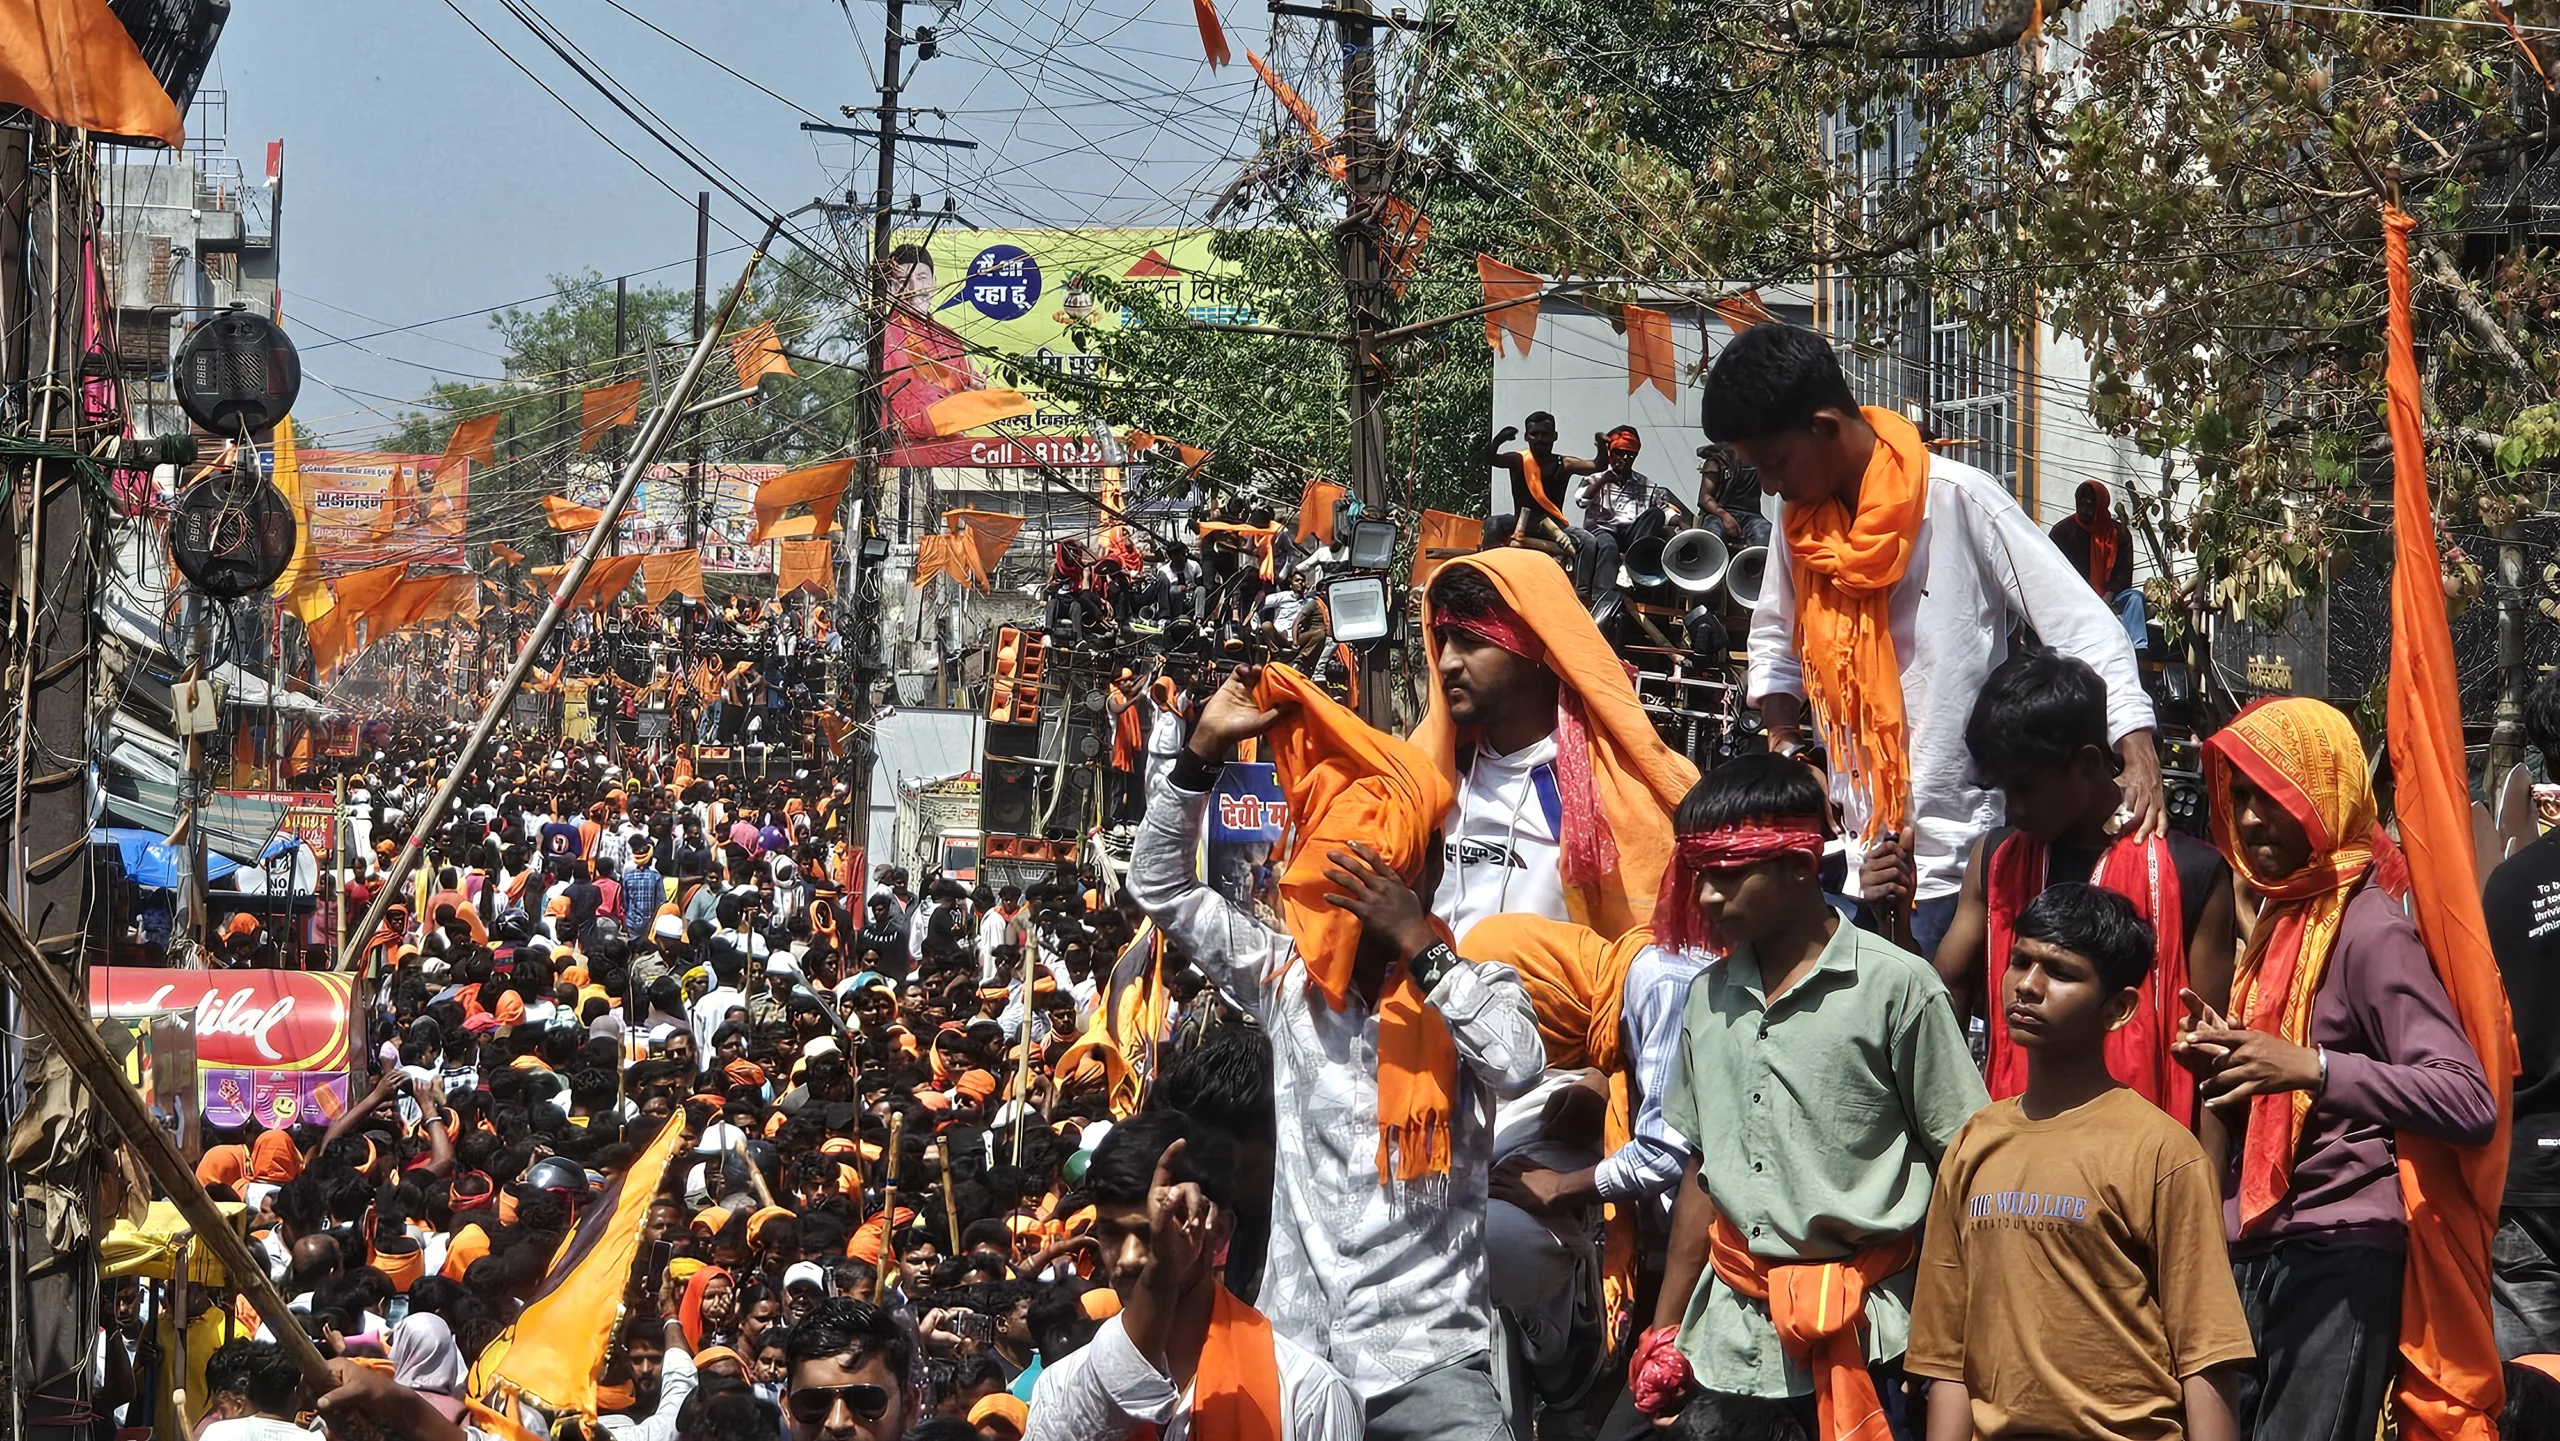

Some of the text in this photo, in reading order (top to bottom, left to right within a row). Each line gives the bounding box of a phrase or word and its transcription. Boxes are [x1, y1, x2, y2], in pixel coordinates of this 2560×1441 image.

[973, 285, 1008, 305] रहा
[971, 442, 1012, 464] Call
[1219, 794, 1289, 830] देवी म
[270, 877, 287, 889] NO
[2537, 880, 2560, 895] To b
[1996, 1191, 2040, 1217] WILD
[2042, 1193, 2088, 1221] LIFE
